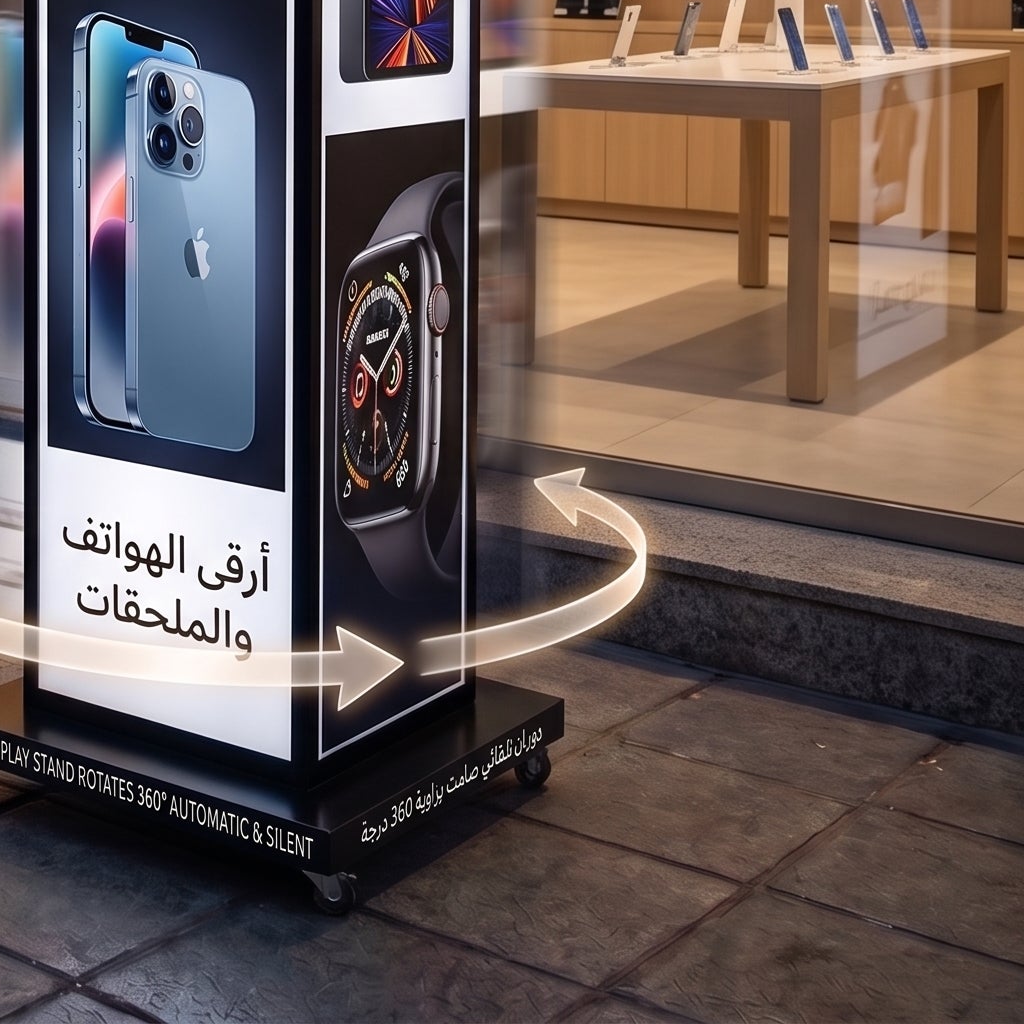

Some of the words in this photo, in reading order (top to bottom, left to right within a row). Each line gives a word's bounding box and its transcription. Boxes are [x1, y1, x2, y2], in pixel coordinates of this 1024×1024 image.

[62, 517, 185, 578] الهواتف
[197, 541, 270, 599] أرقى
[76, 583, 253, 662] والملحقات
[513, 727, 543, 757] دوران
[446, 764, 479, 794] صامت
[33, 751, 75, 783] STAND
[78, 765, 134, 803] ROTATES
[137, 784, 167, 812] 360°
[169, 795, 249, 840] AUTOMATIC
[252, 821, 263, 845] &
[266, 825, 314, 860] SILENT
[390, 796, 413, 827] 360
[360, 817, 388, 844] درجة
